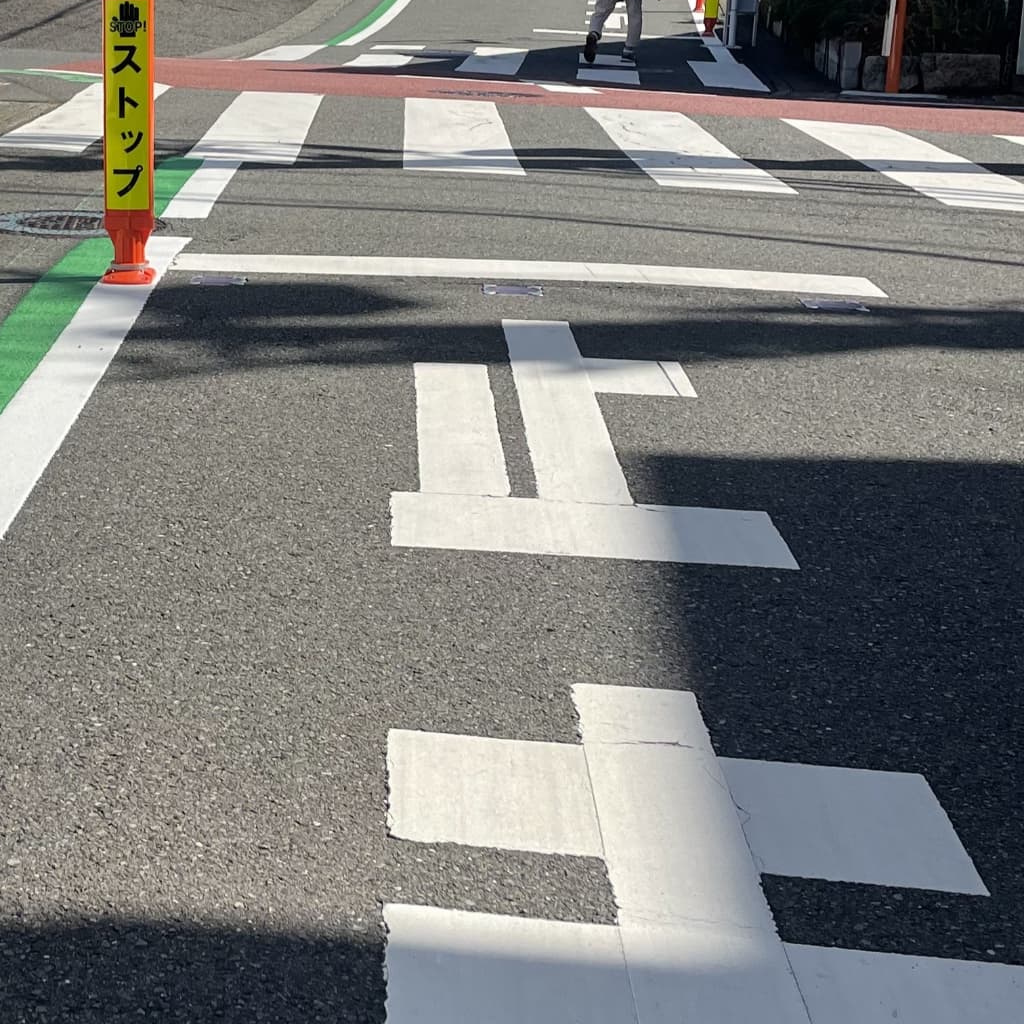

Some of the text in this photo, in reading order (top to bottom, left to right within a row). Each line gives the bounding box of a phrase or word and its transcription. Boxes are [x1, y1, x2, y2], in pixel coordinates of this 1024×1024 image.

[109, 20, 147, 33] STOP!
[111, 45, 144, 197] ストップ
